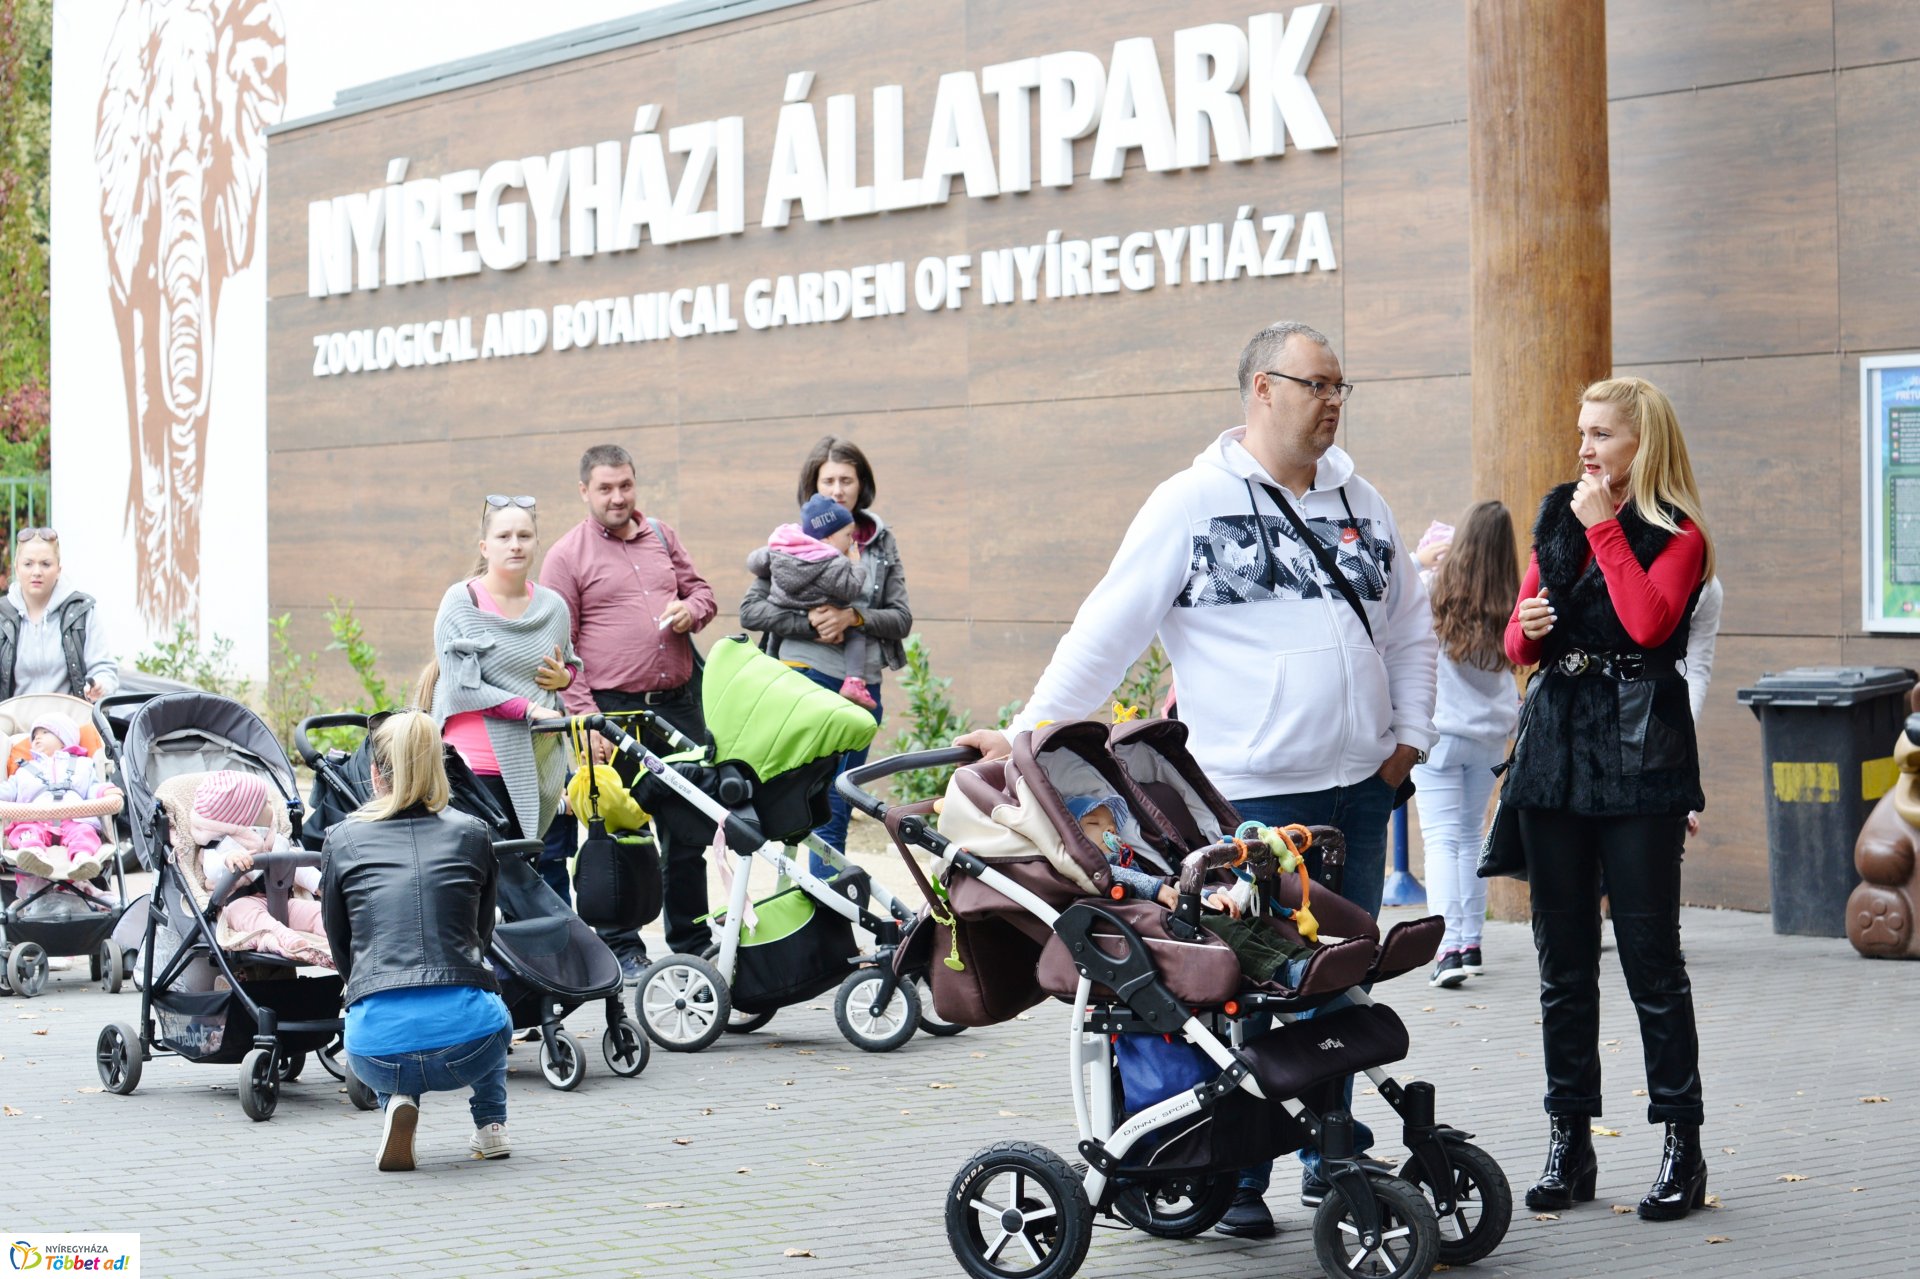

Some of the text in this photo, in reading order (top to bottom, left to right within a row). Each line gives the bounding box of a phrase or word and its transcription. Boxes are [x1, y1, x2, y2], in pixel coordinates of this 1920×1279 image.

[308, 3, 1338, 298] NYÍREGYHÁZI ÁLLATPARK
[313, 205, 1337, 377] ZOOLOGICAL AND BOTANICAL GARDEN OF NYÍREGYHÁZA
[1123, 1099, 1196, 1137] DANNY SPORT
[956, 1164, 984, 1201] KENDA
